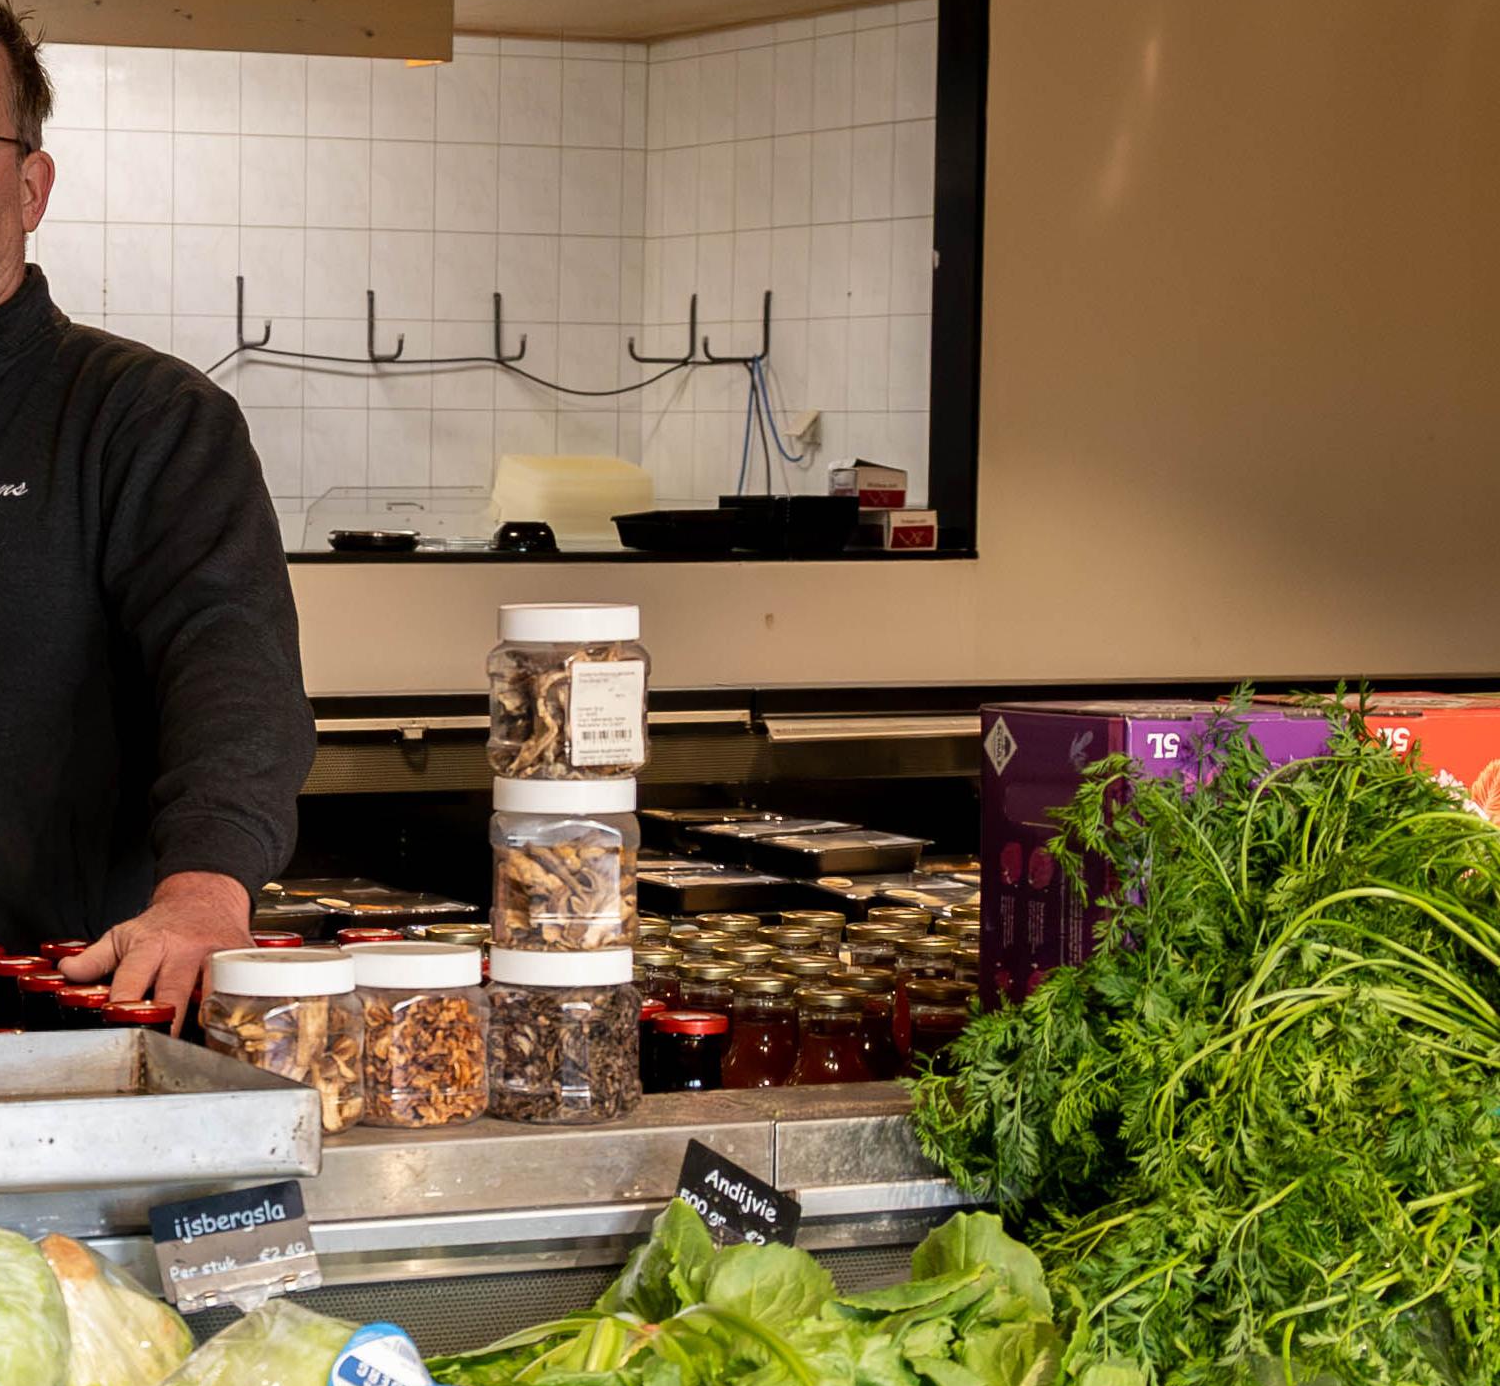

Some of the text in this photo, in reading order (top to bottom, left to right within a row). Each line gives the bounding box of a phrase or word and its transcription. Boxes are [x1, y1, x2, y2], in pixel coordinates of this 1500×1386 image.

[1147, 733, 1180, 758] 5L
[679, 1187, 709, 1215] 500
[704, 1169, 777, 1223] Andijvie
[174, 1200, 286, 1243] ijsbergsla
[169, 1265, 198, 1282] Per
[202, 1255, 236, 1276] stuk
